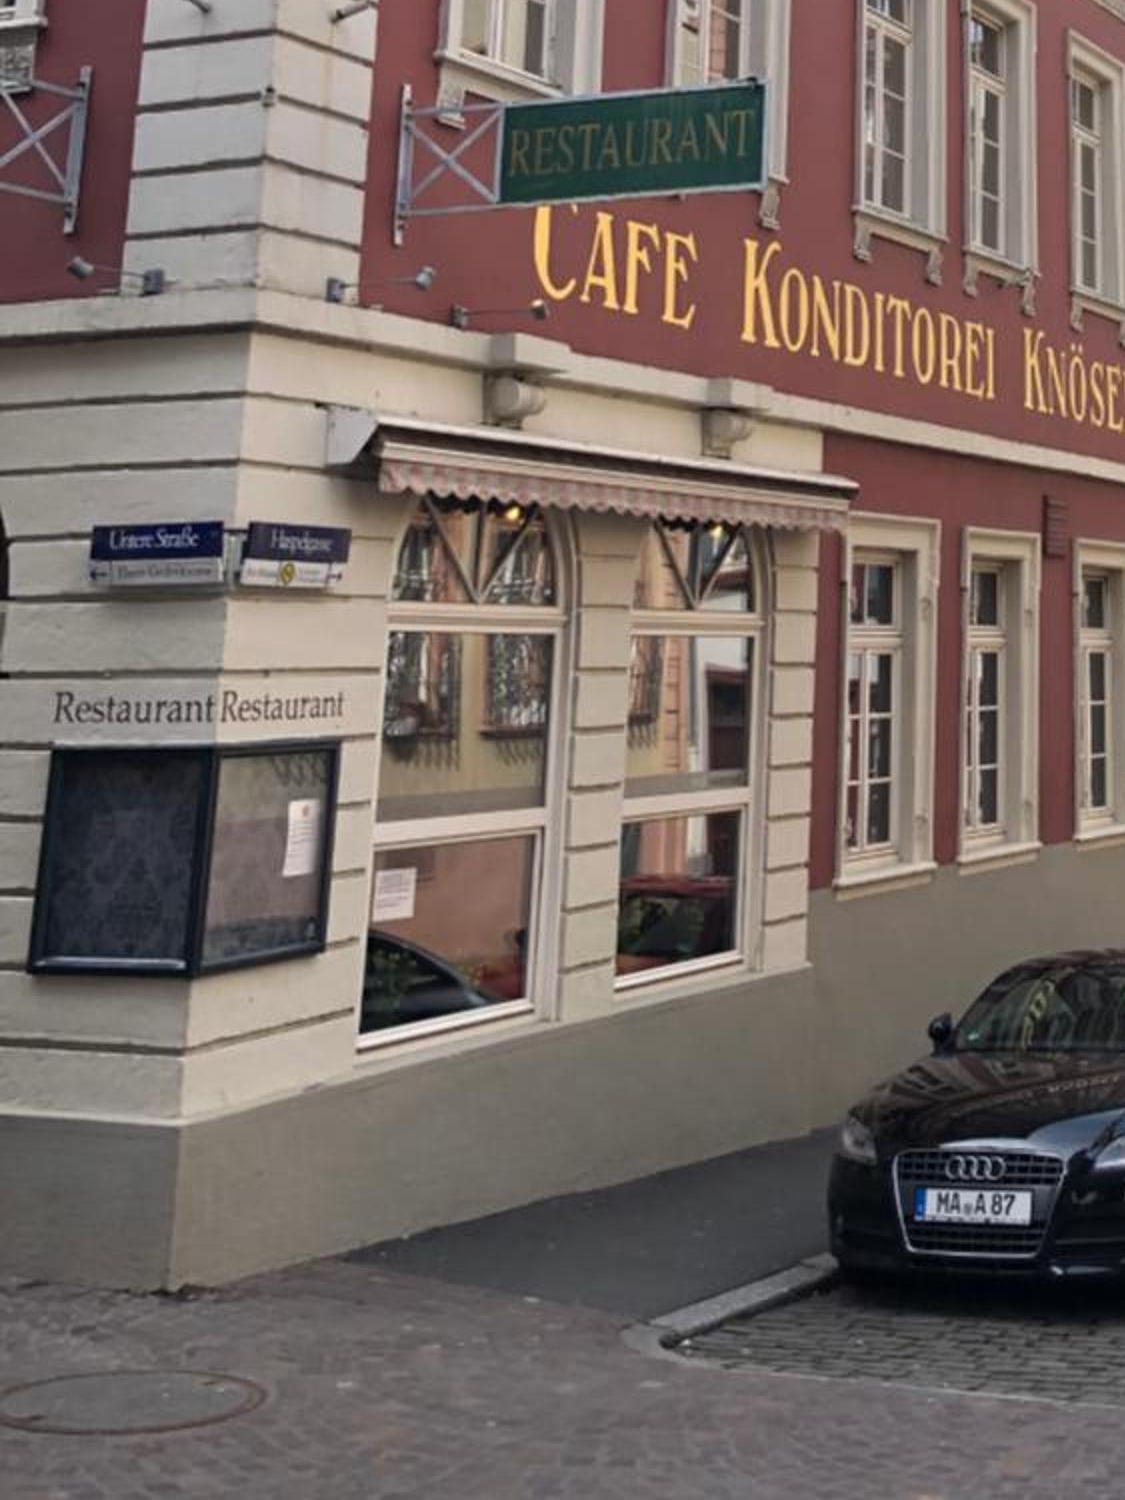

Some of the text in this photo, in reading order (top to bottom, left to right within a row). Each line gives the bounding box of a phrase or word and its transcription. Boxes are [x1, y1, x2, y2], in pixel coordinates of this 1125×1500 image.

[509, 109, 755, 177] RESTAURANT
[533, 204, 698, 329] CAFE
[741, 238, 996, 400] KONDITOREI
[155, 525, 199, 548] Straße
[54, 691, 214, 723] Restaurant
[220, 690, 343, 722] Restaurant
[936, 1191, 1017, 1216] MA A 87
